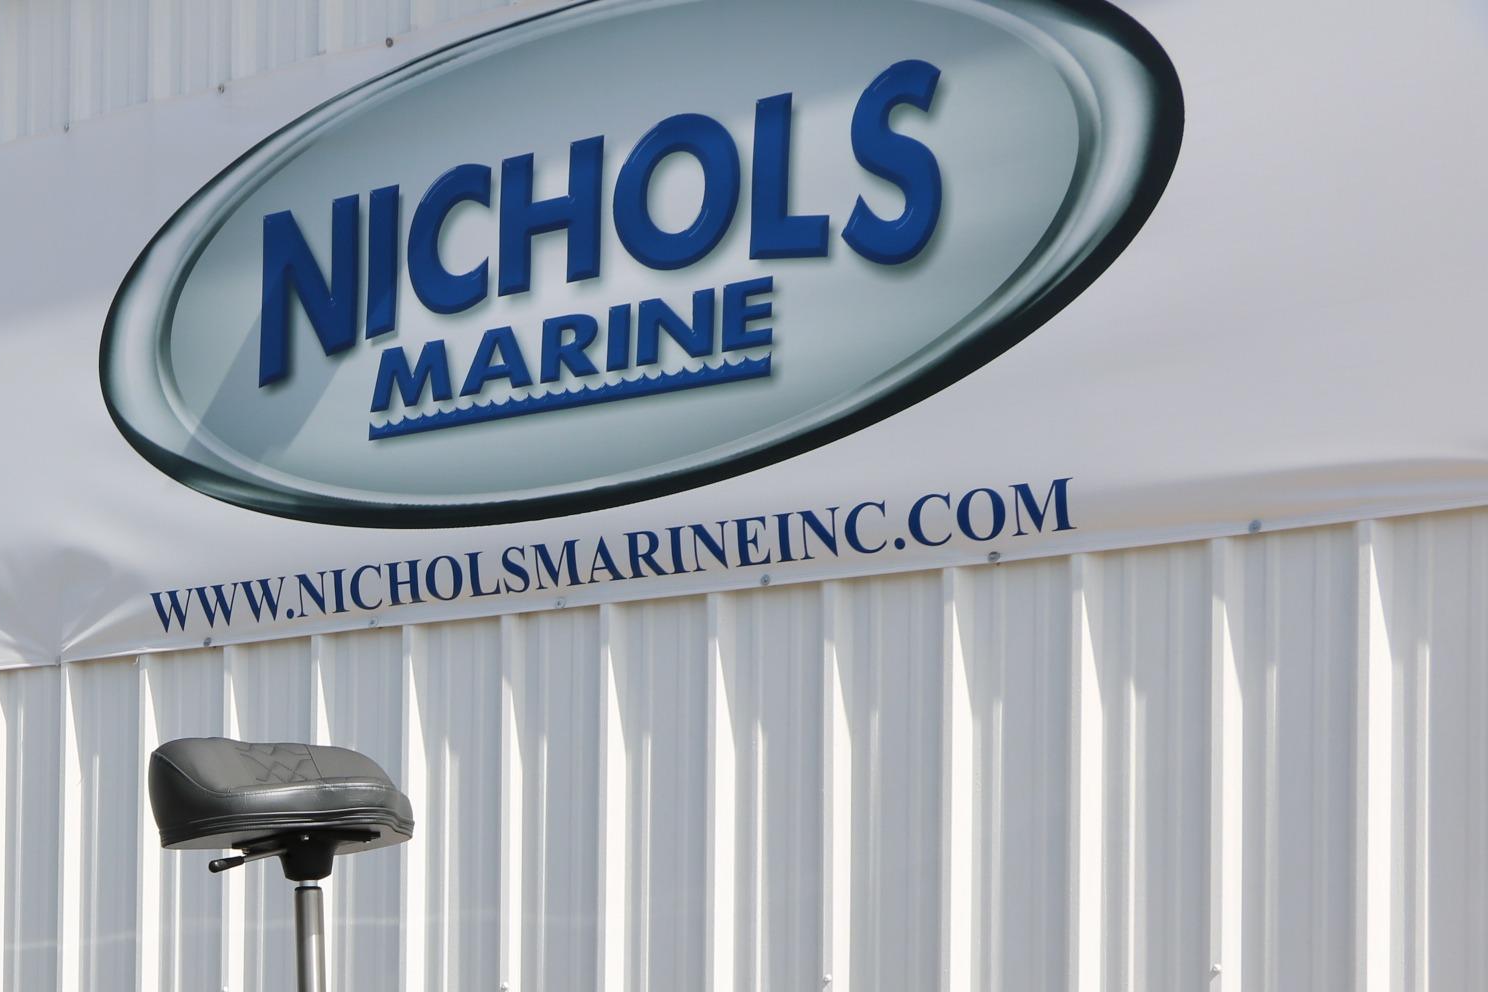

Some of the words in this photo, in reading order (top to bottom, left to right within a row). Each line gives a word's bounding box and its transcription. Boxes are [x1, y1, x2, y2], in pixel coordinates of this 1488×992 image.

[258, 59, 943, 388] NICHOLS
[370, 275, 774, 413] MARINE
[150, 477, 1078, 633] WWW.NICHOLSMARINEINC.COM
